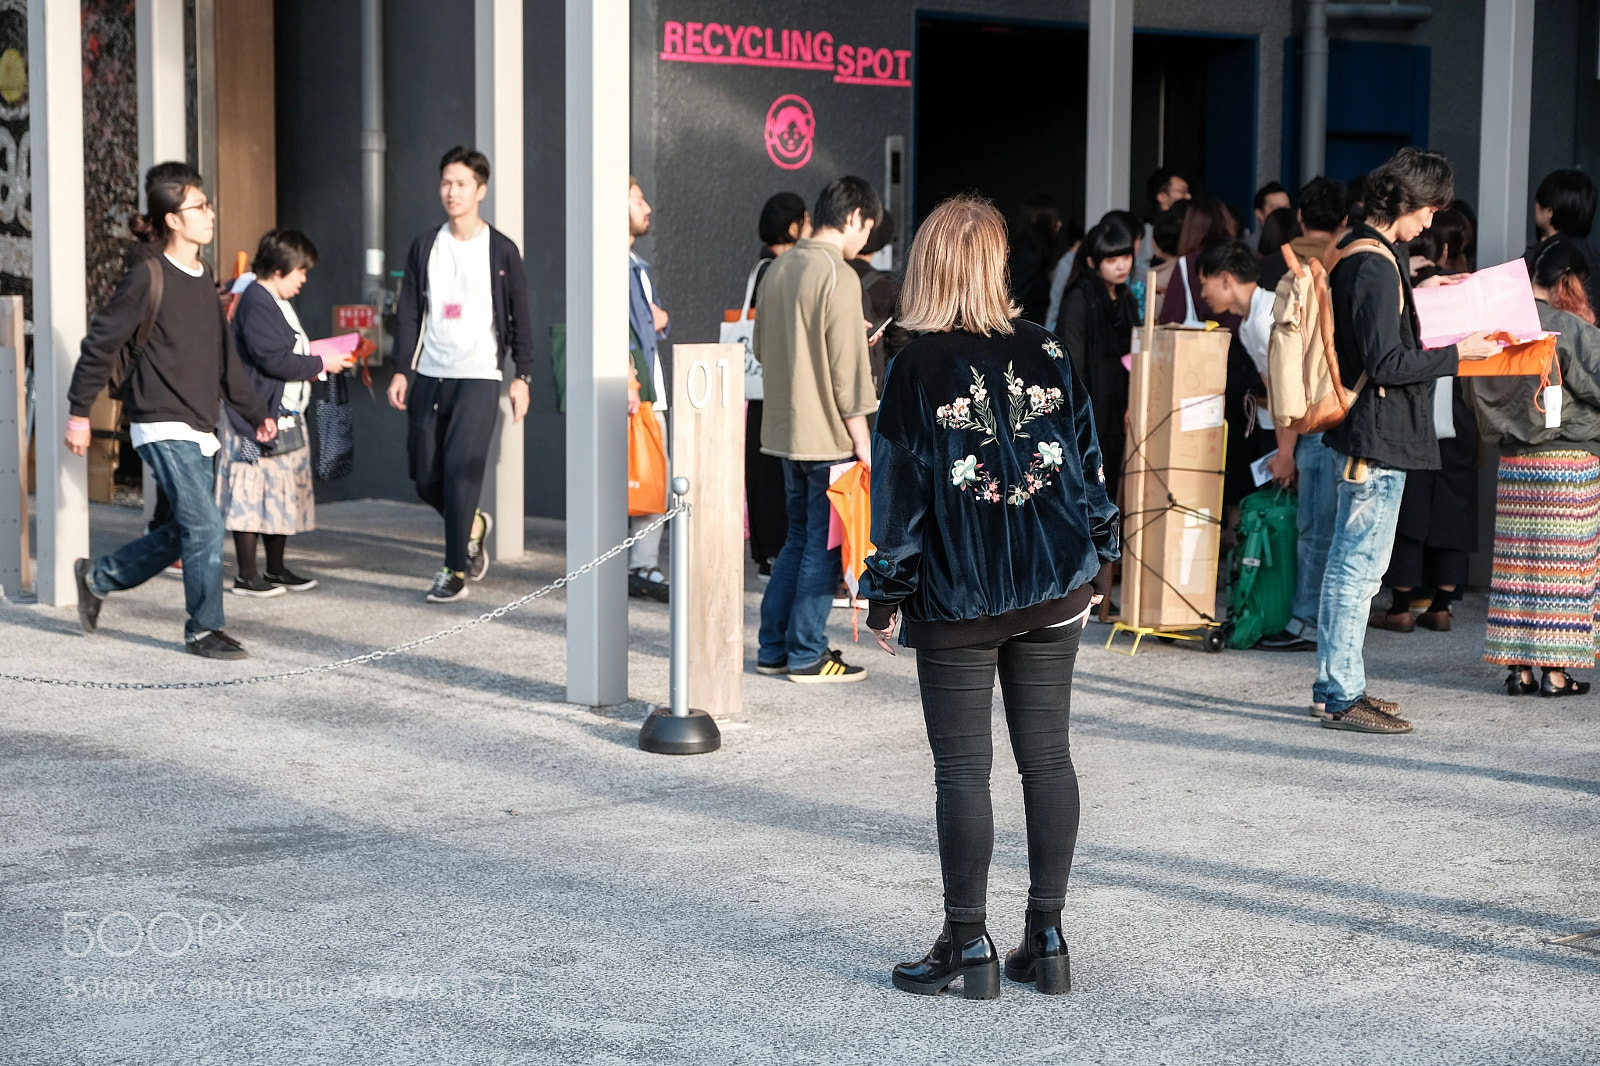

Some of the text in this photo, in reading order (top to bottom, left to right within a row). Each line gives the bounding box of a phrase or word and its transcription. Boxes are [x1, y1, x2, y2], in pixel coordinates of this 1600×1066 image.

[664, 20, 912, 80] RECYCLING SPOT
[687, 358, 729, 409] 01
